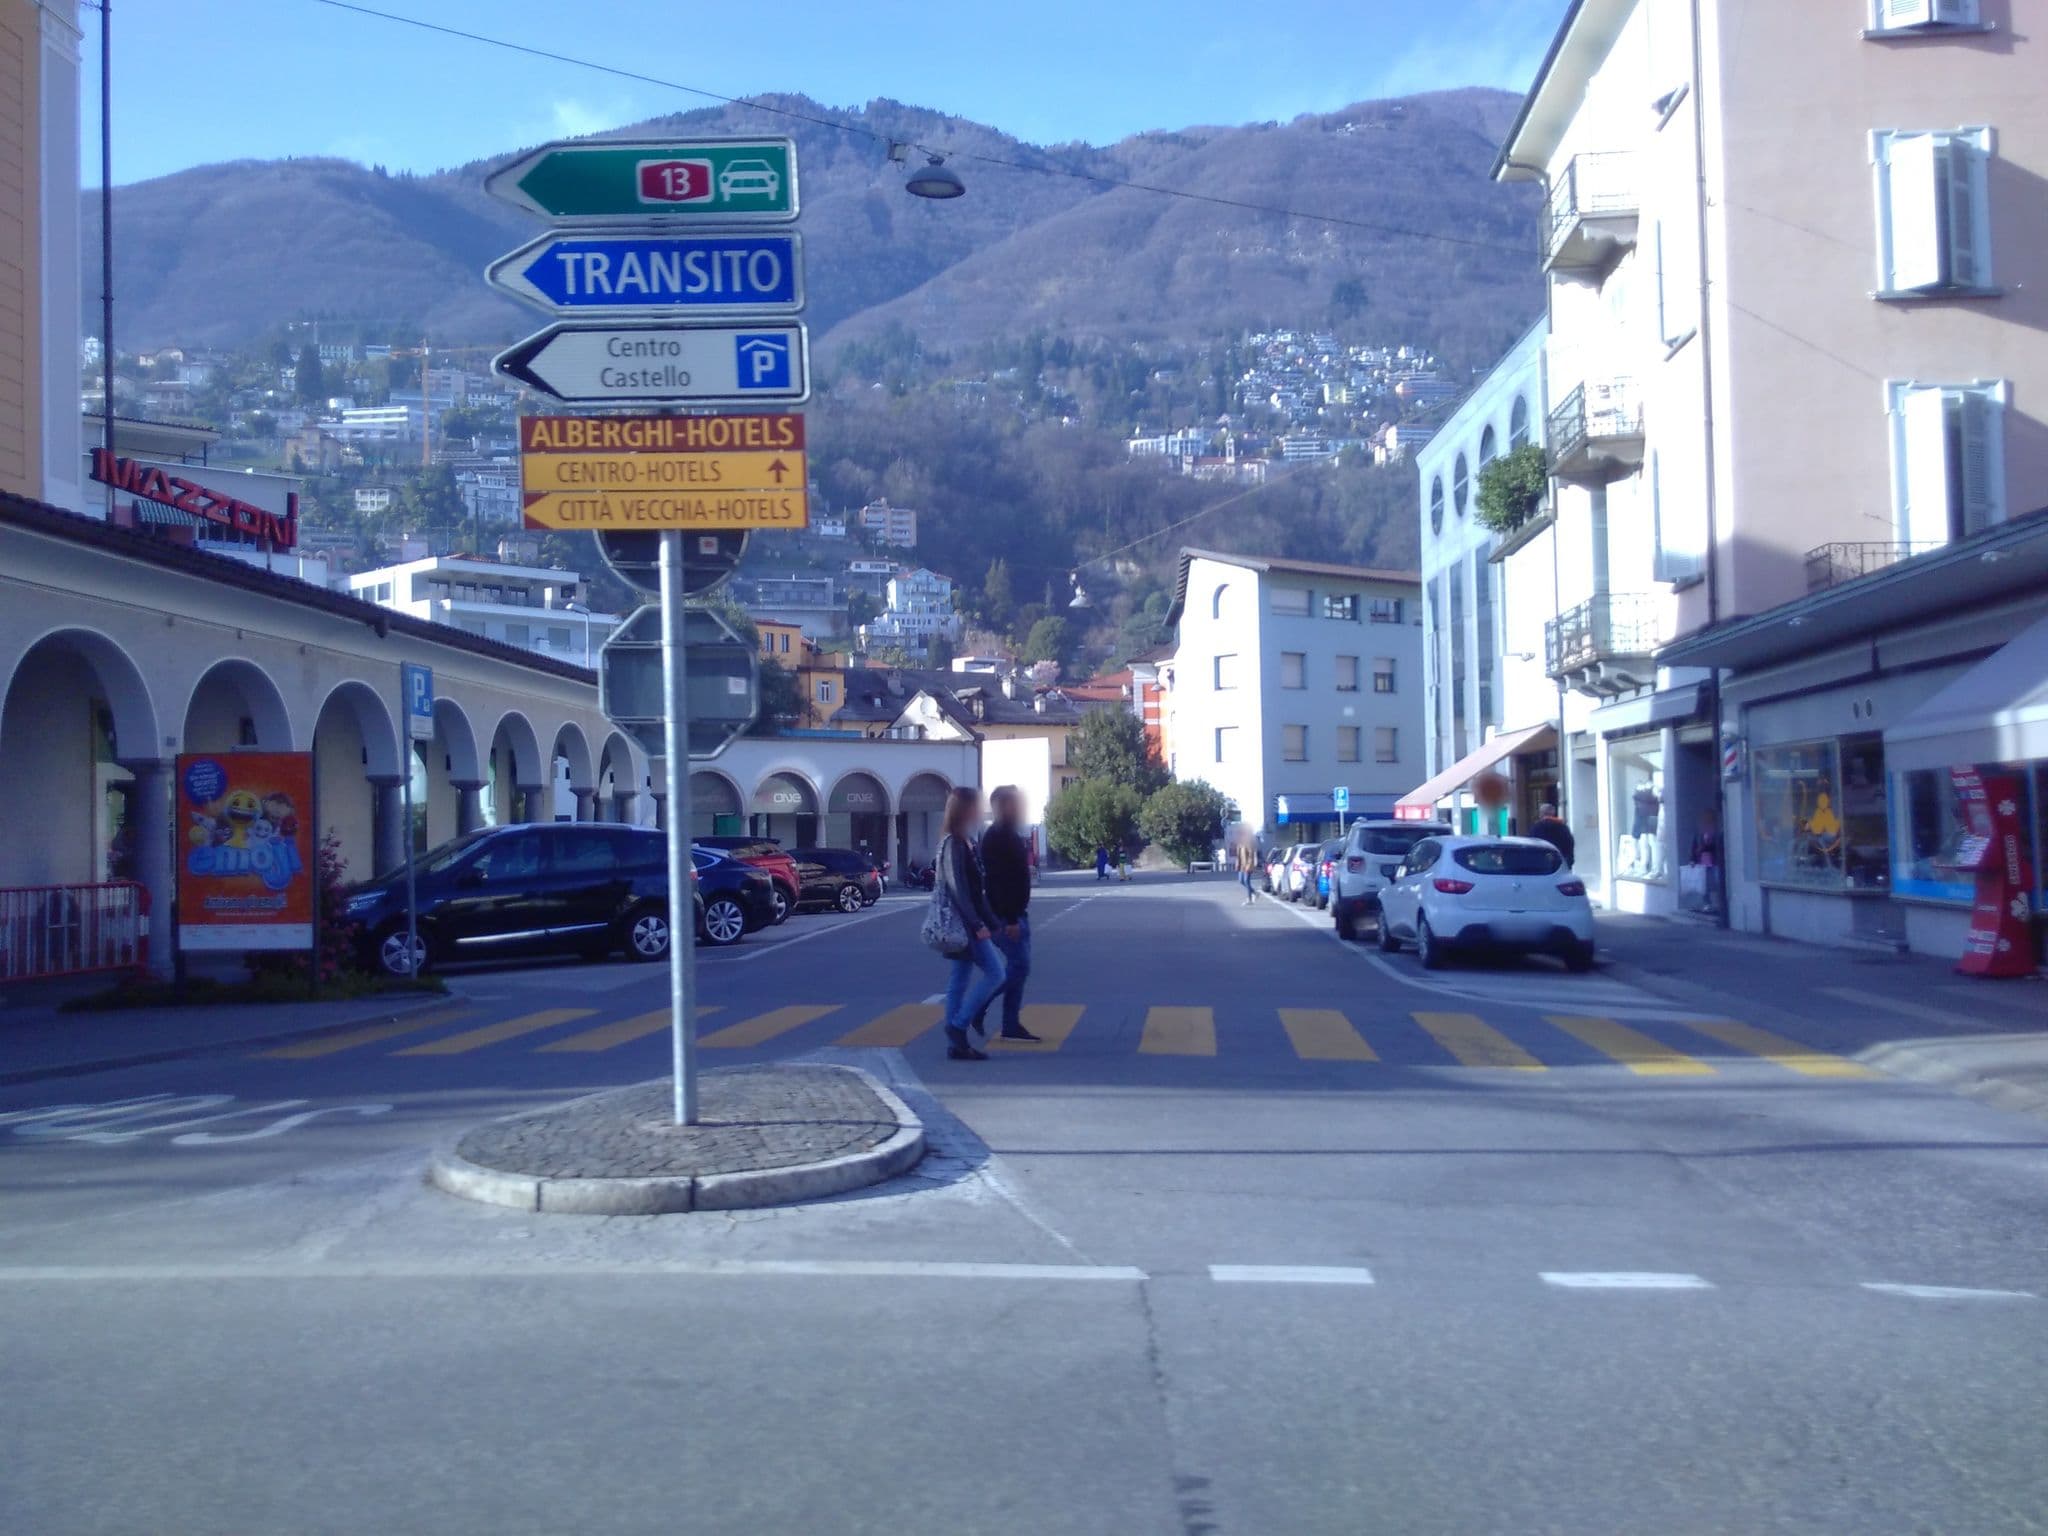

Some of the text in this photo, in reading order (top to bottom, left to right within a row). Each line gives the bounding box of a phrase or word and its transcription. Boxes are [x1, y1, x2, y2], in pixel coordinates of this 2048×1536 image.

[661, 167, 691, 195] 13
[556, 249, 782, 295] TRANSITO
[606, 336, 682, 358] Centro
[600, 365, 692, 388] Castello
[752, 350, 775, 383] P
[530, 417, 795, 448] ALBERGHI-HOTELS
[556, 460, 722, 483] CENTRO-HOTELS
[558, 495, 793, 521] CITTÀ VECCHIA-HOTELS
[188, 836, 303, 890] emoji
